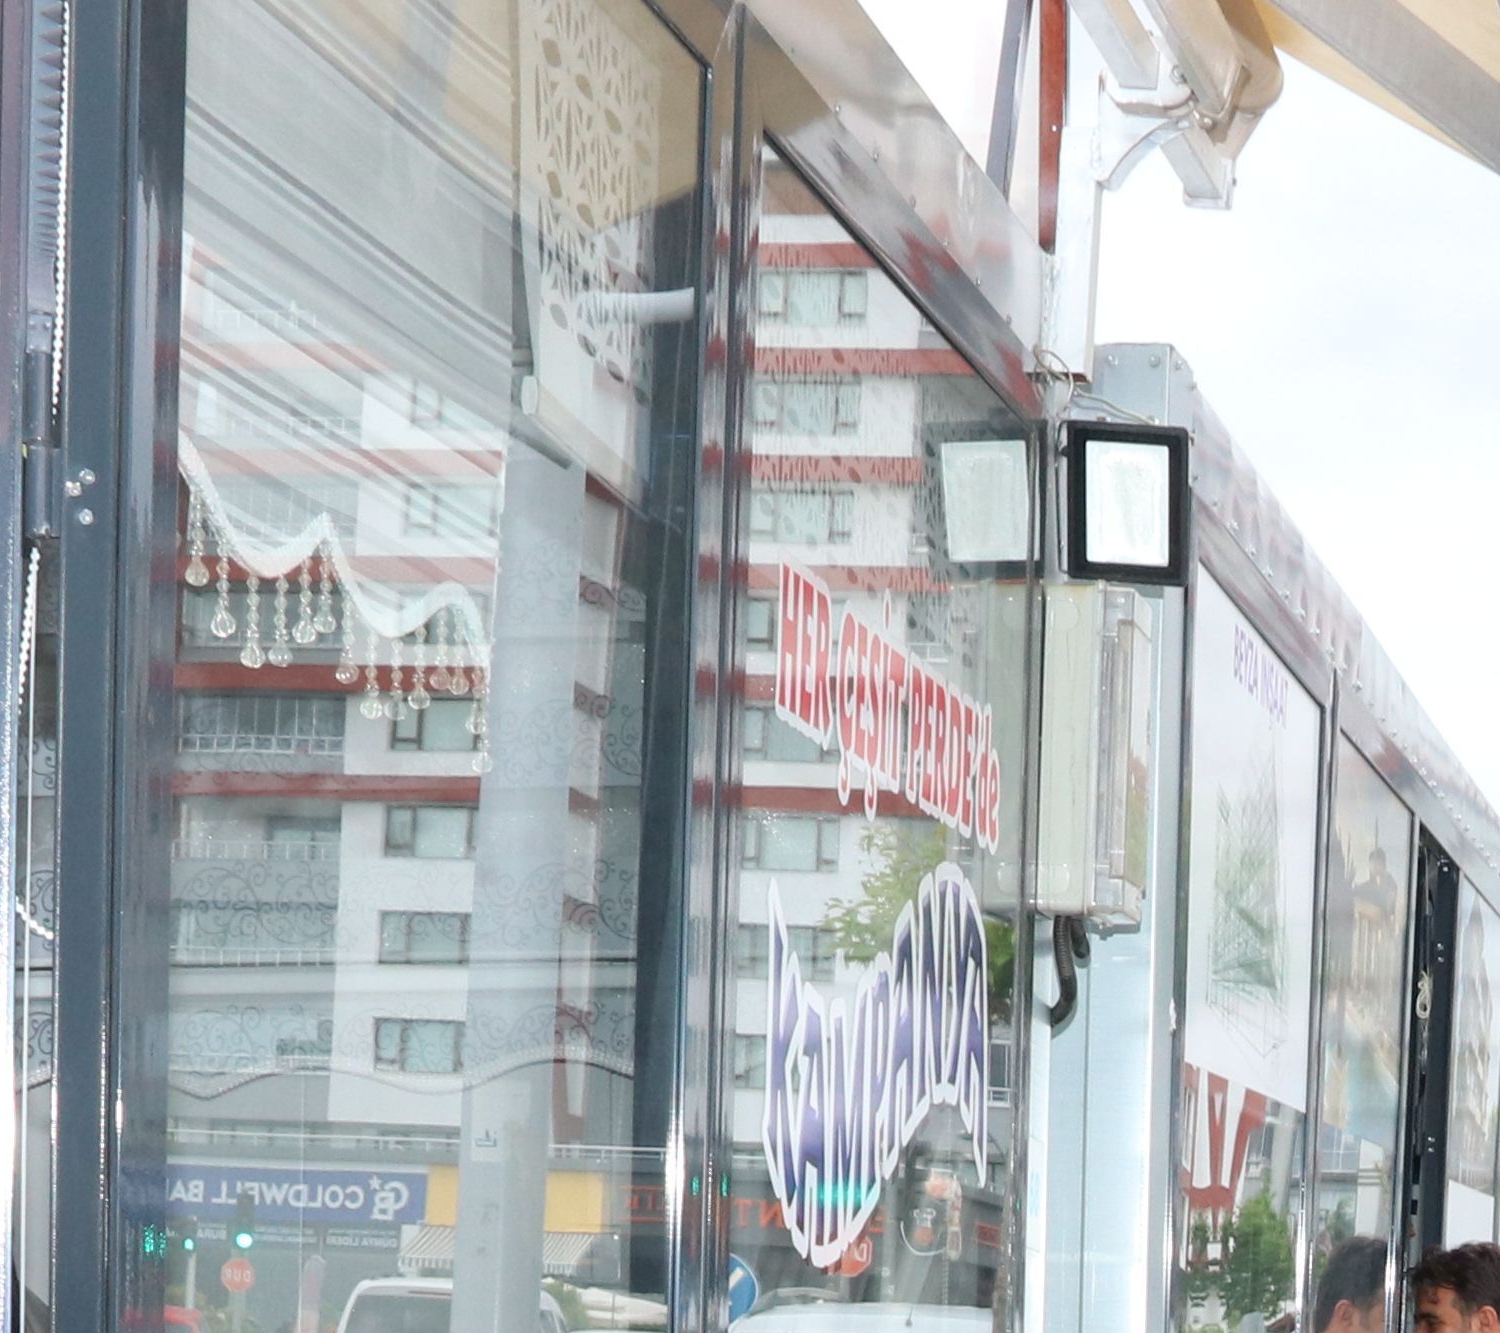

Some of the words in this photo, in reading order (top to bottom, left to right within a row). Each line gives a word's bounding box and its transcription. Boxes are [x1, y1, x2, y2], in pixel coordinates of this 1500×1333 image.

[775, 556, 833, 750] HER
[837, 588, 907, 821] ÇEŞİT
[763, 862, 987, 1267] KAMPANYA
